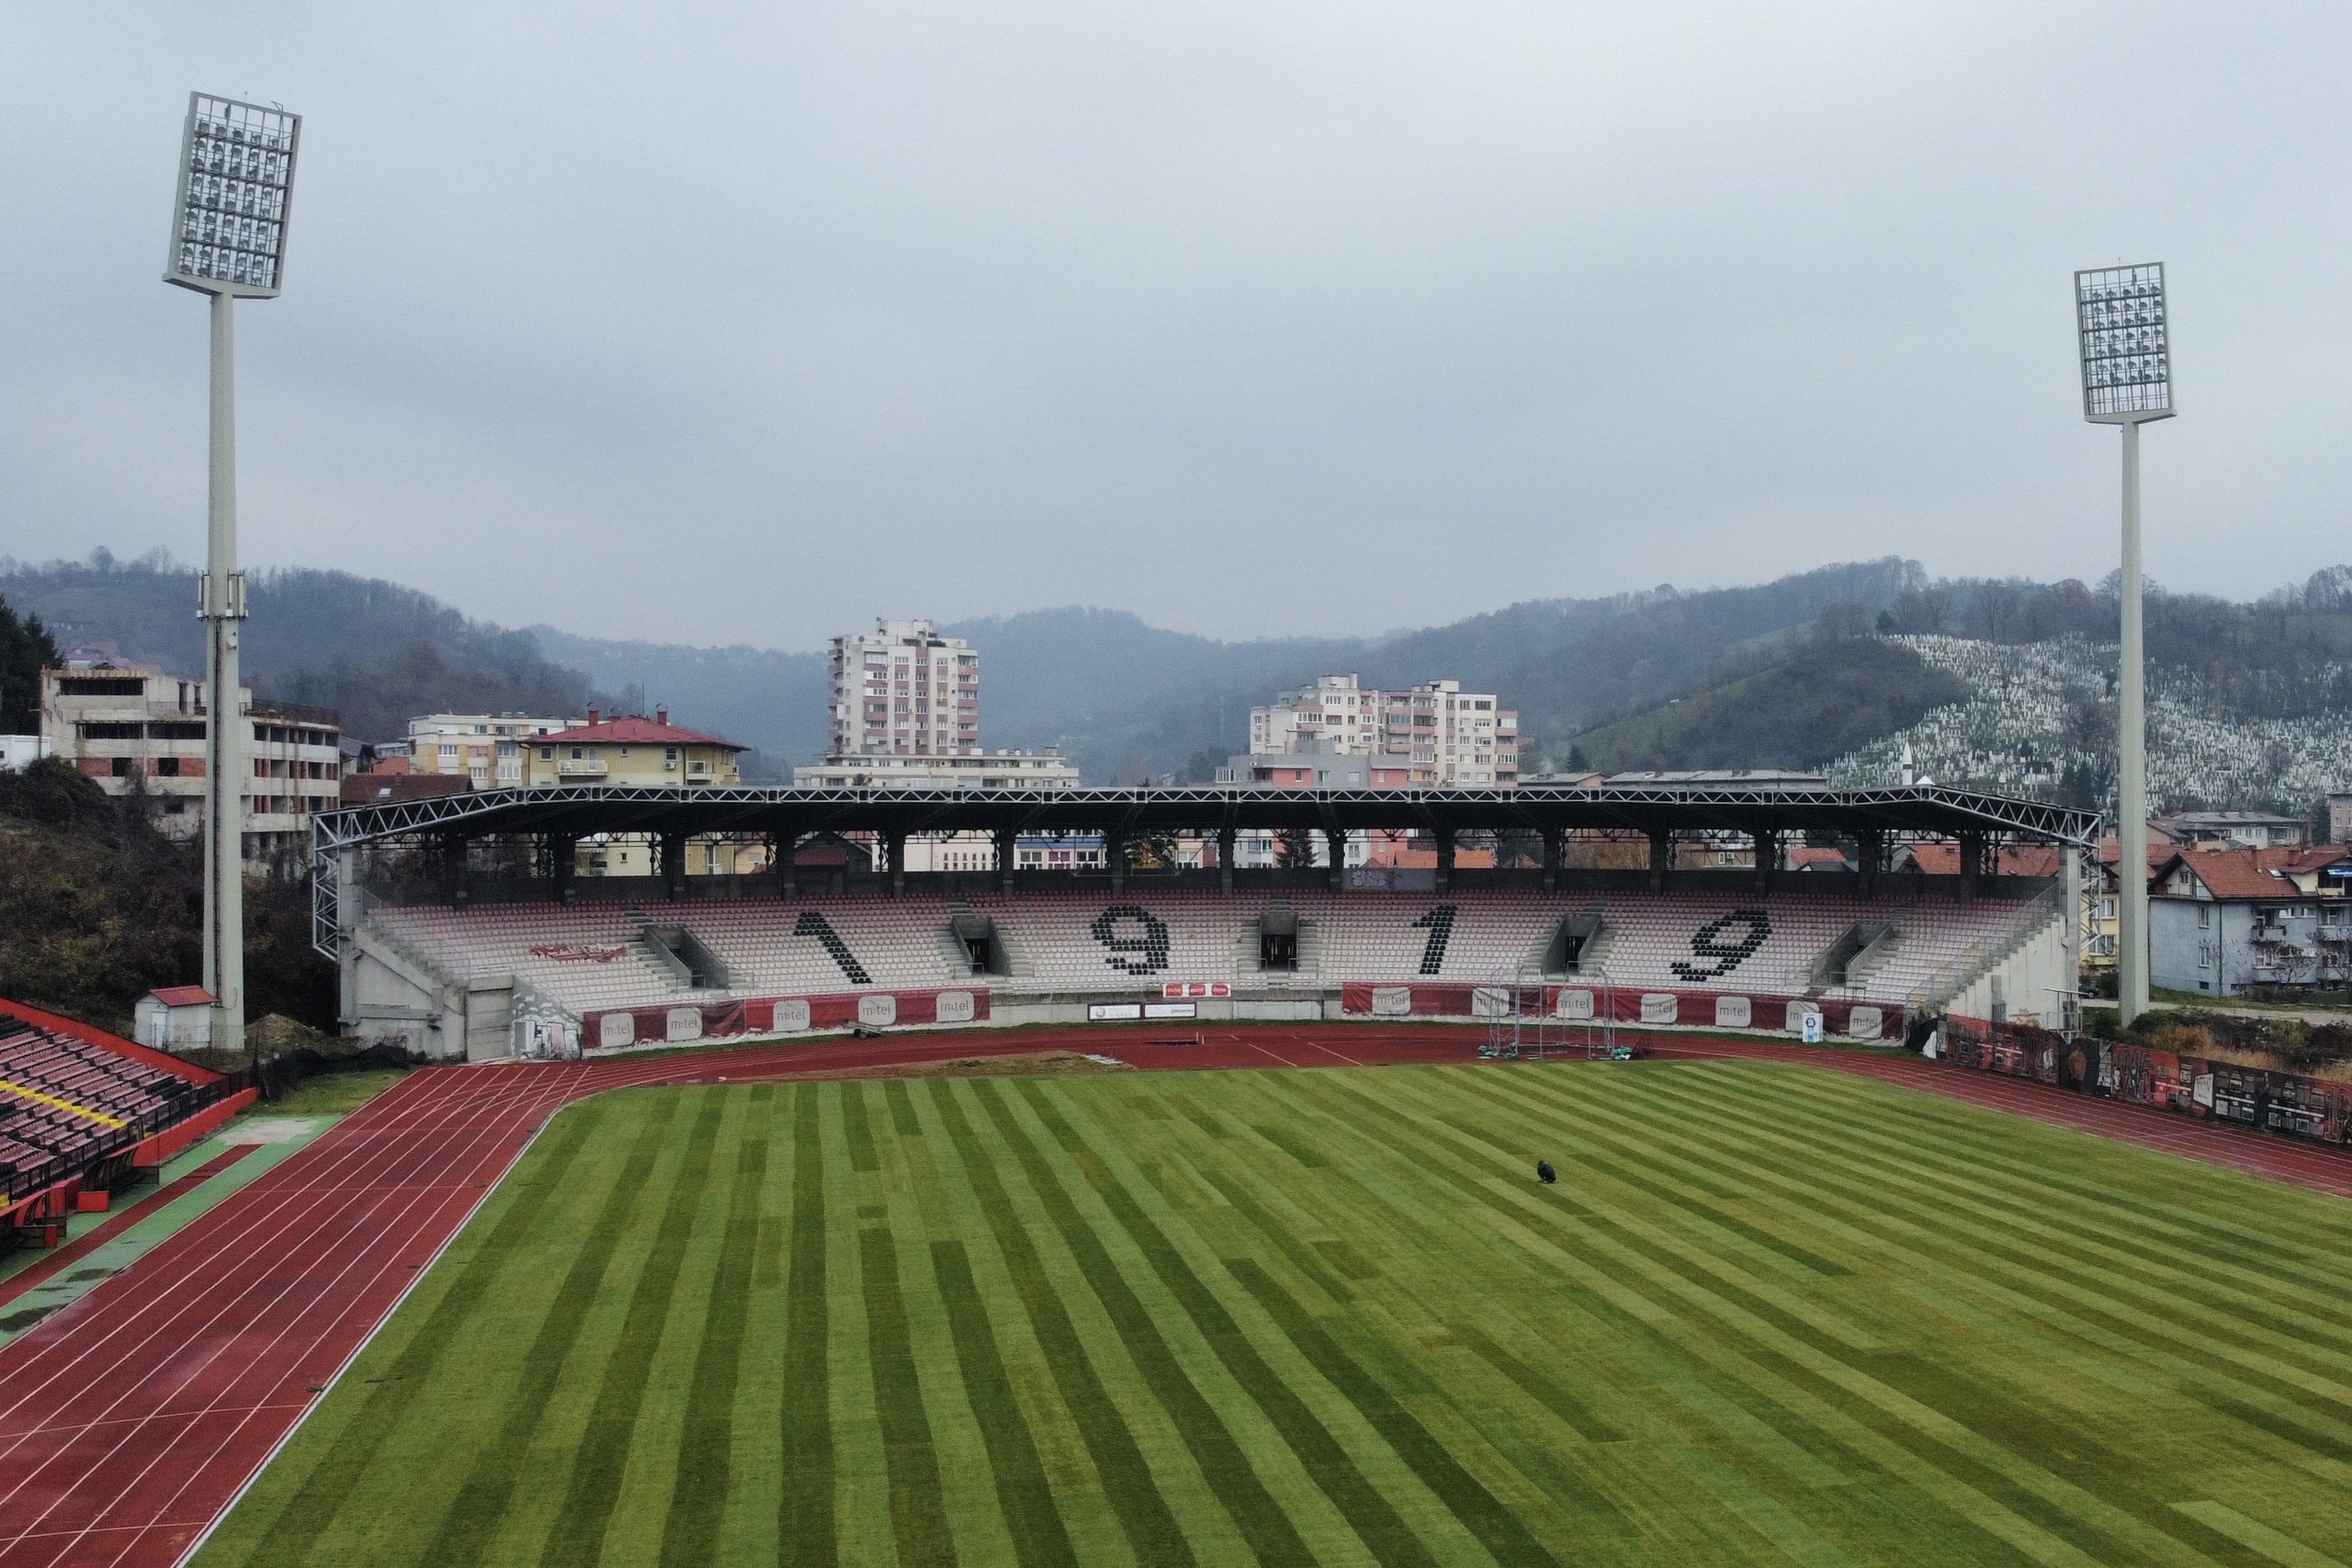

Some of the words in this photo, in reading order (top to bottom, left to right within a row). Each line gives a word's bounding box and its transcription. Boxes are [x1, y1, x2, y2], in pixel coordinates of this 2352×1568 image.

[794, 911, 873, 984] 1
[1090, 906, 1169, 975] 9
[1411, 906, 1457, 975] 1
[1670, 909, 1773, 981] 9
[1377, 994, 1405, 1005] m:tel
[1561, 998, 1589, 1009] m:tel
[864, 1004, 890, 1016] m:tel
[941, 1000, 969, 1012] m:tel
[1644, 1003, 1672, 1013] m:tel
[1720, 1006, 1746, 1017] m:tel
[777, 1009, 805, 1021] m:tel
[604, 1022, 630, 1035] m:tel
[671, 1017, 698, 1029] m:tel
[1853, 1017, 1878, 1028] m:tel
